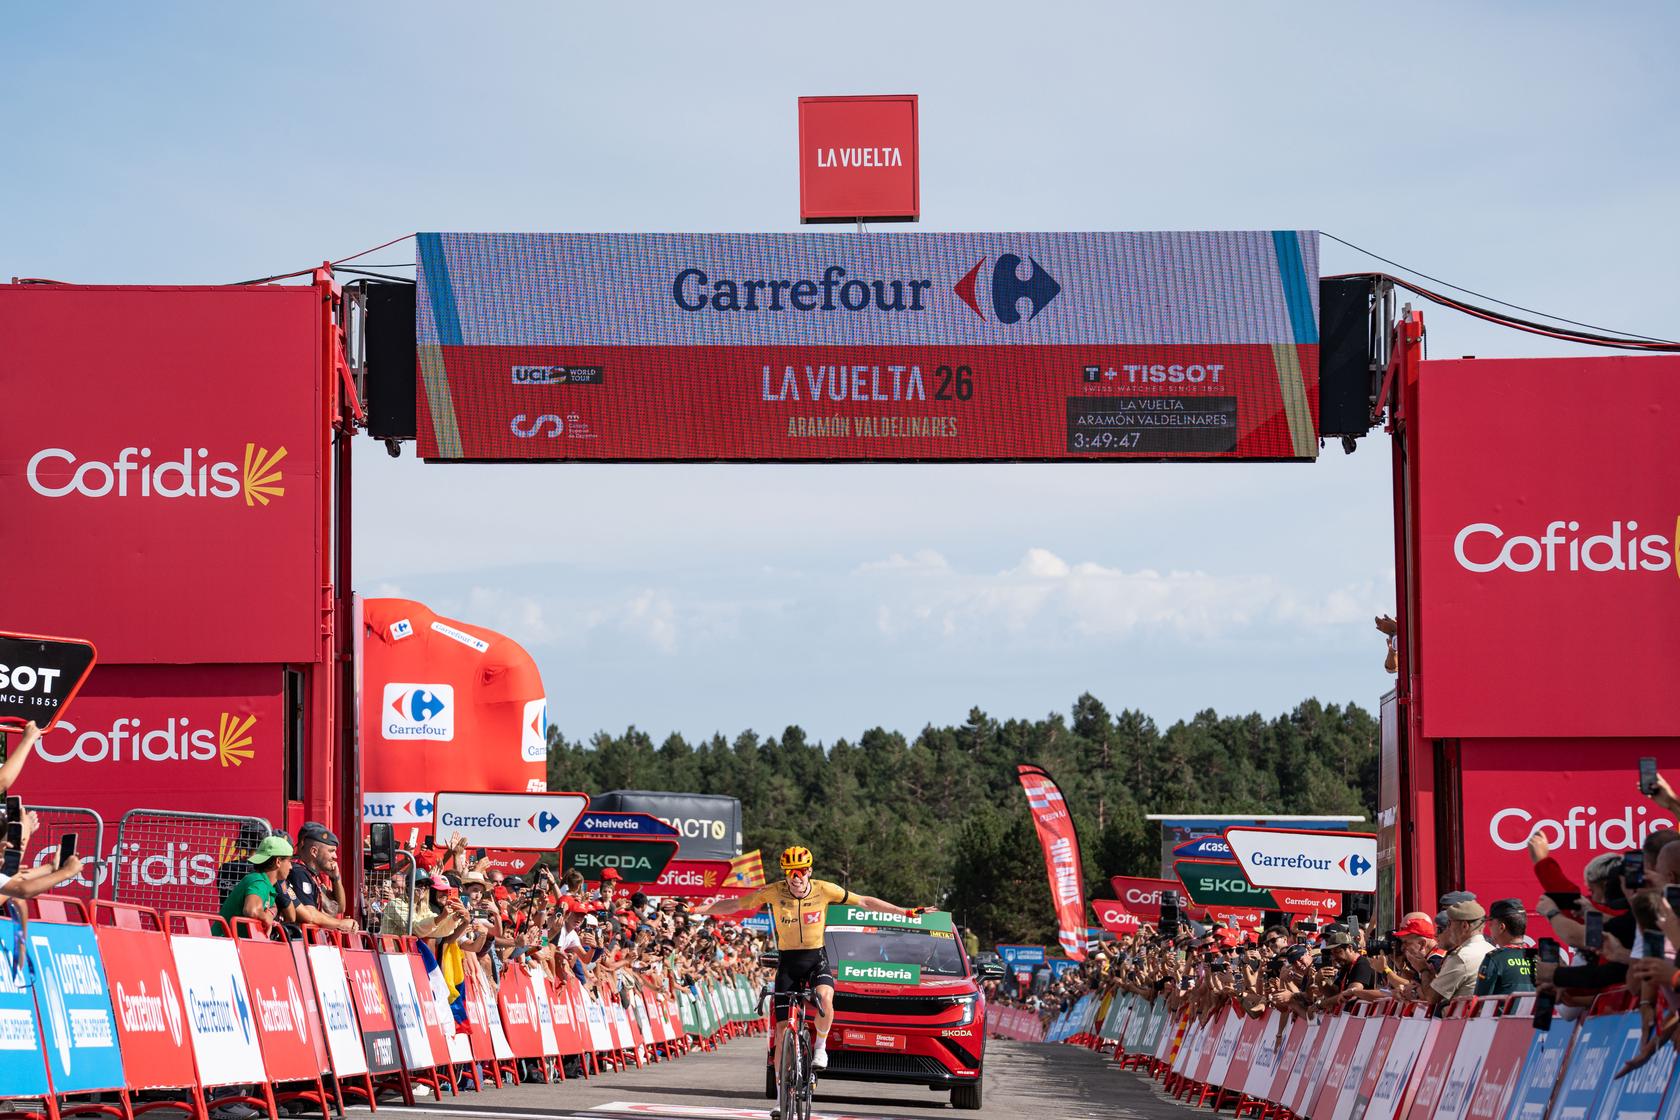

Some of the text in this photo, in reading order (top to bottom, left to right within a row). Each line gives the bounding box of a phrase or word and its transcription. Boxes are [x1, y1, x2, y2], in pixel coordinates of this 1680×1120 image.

[817, 147, 903, 167] LA VUELTA
[673, 266, 931, 312] Carrefour
[515, 368, 547, 382] UCI
[762, 365, 974, 401] LA VUELTA 26
[1122, 364, 1225, 384] TISSOT
[1120, 400, 1184, 410] LA VUELTA
[787, 413, 958, 437] ARAMÓN VALDELINARES
[1078, 412, 1227, 426] ARAMÓN VALDELINARES
[1074, 432, 1141, 448] 3:49:47
[26, 447, 241, 498] Cofidis
[1454, 520, 1672, 573] Cofidis
[435, 624, 472, 644] Carrefour
[0, 694, 58, 707] NCE 1853
[389, 724, 447, 736] Carrefour
[34, 717, 217, 763] Cofidis
[442, 812, 521, 828] Carrefour
[595, 818, 639, 829] helvetia
[1205, 842, 1230, 853] case
[1251, 852, 1332, 870] Carrefour
[1126, 889, 1187, 908] Cofis
[1285, 898, 1320, 907] Carrefour
[1217, 912, 1245, 921] Carrour
[845, 967, 912, 980] Fertiberia
[117, 980, 166, 1032] Carrefour
[189, 986, 234, 1034] Carrefour
[256, 986, 293, 1032] Carrefour
